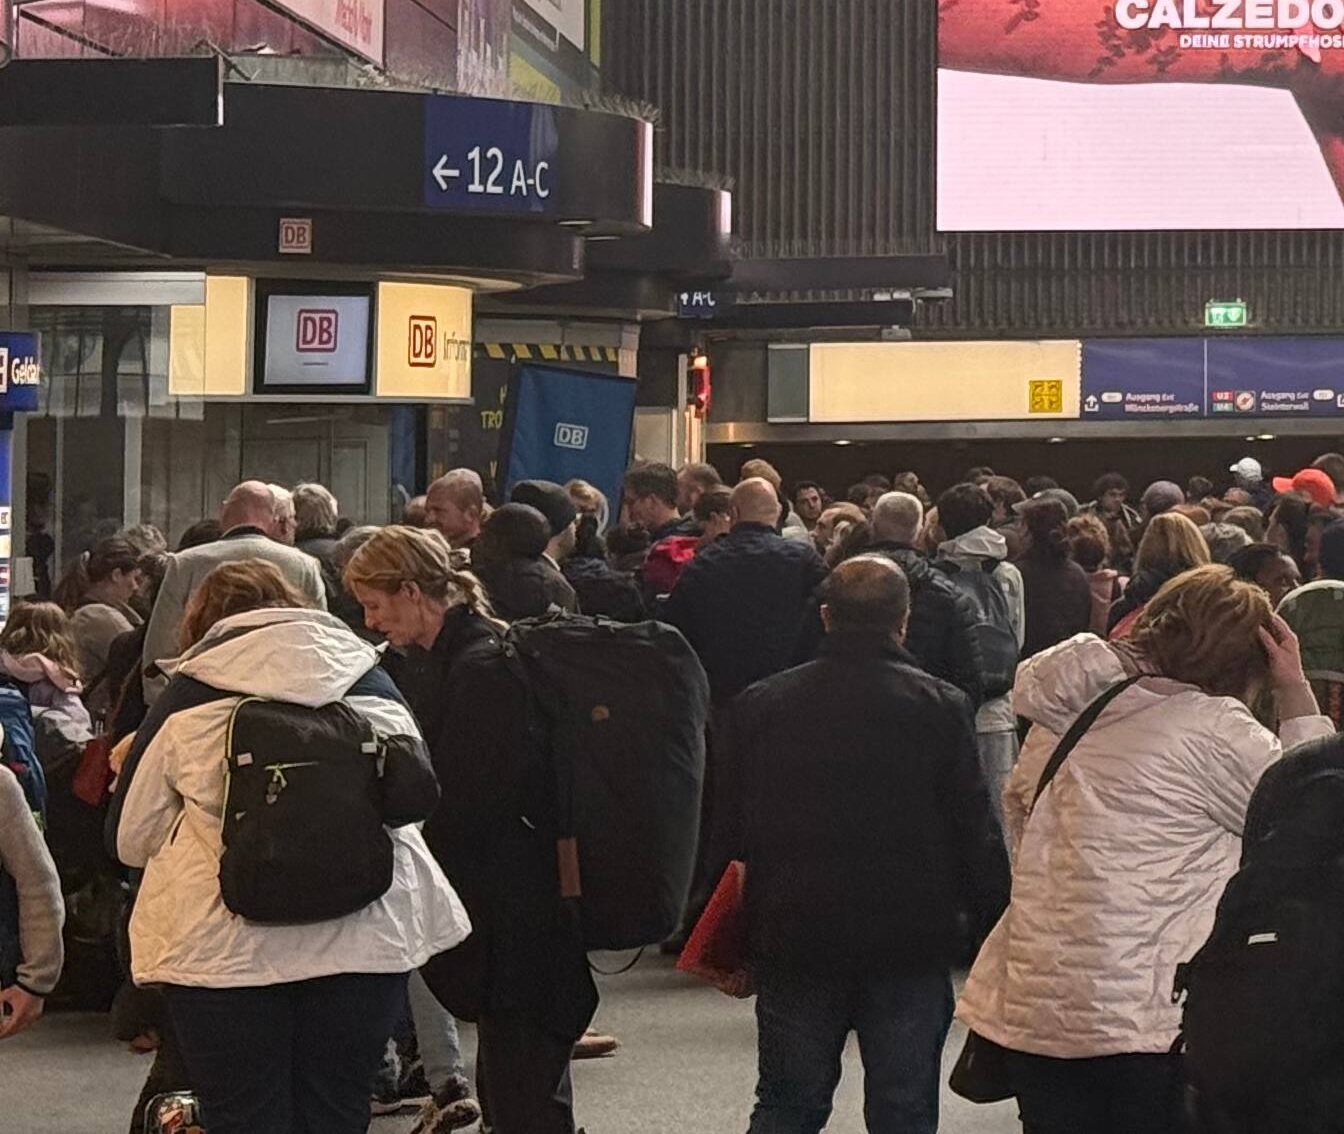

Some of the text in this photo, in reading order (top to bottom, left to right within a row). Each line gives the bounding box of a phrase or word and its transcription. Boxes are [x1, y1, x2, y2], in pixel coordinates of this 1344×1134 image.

[1179, 33, 1230, 49] DEINE
[467, 145, 549, 198] 12 A-C
[285, 225, 307, 245] DB
[302, 316, 333, 346] DB
[412, 324, 434, 359] DB
[558, 426, 584, 446] DB
